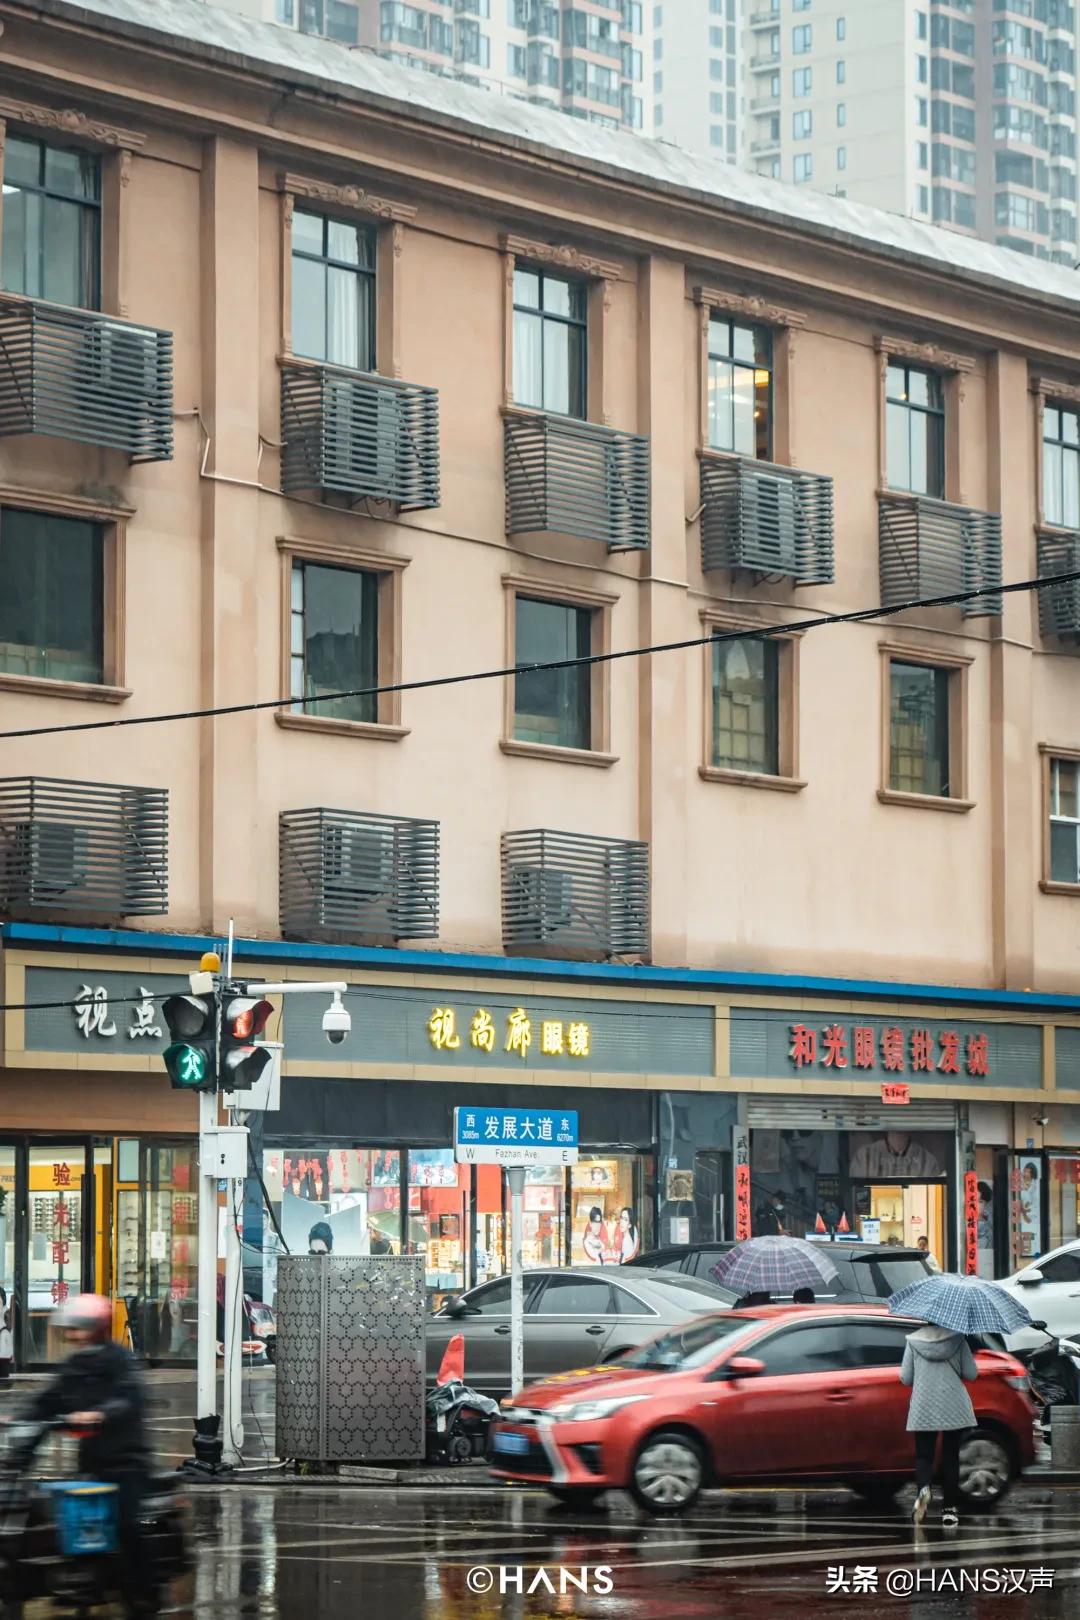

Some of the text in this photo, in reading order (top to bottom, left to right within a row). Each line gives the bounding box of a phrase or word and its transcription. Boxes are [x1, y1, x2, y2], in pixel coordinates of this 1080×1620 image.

[790, 1023, 989, 1075] 和光眼镜批发城
[466, 1114, 570, 1141] 西 发展大道 东
[466, 1148, 475, 1160] W
[562, 1150, 568, 1162] E
